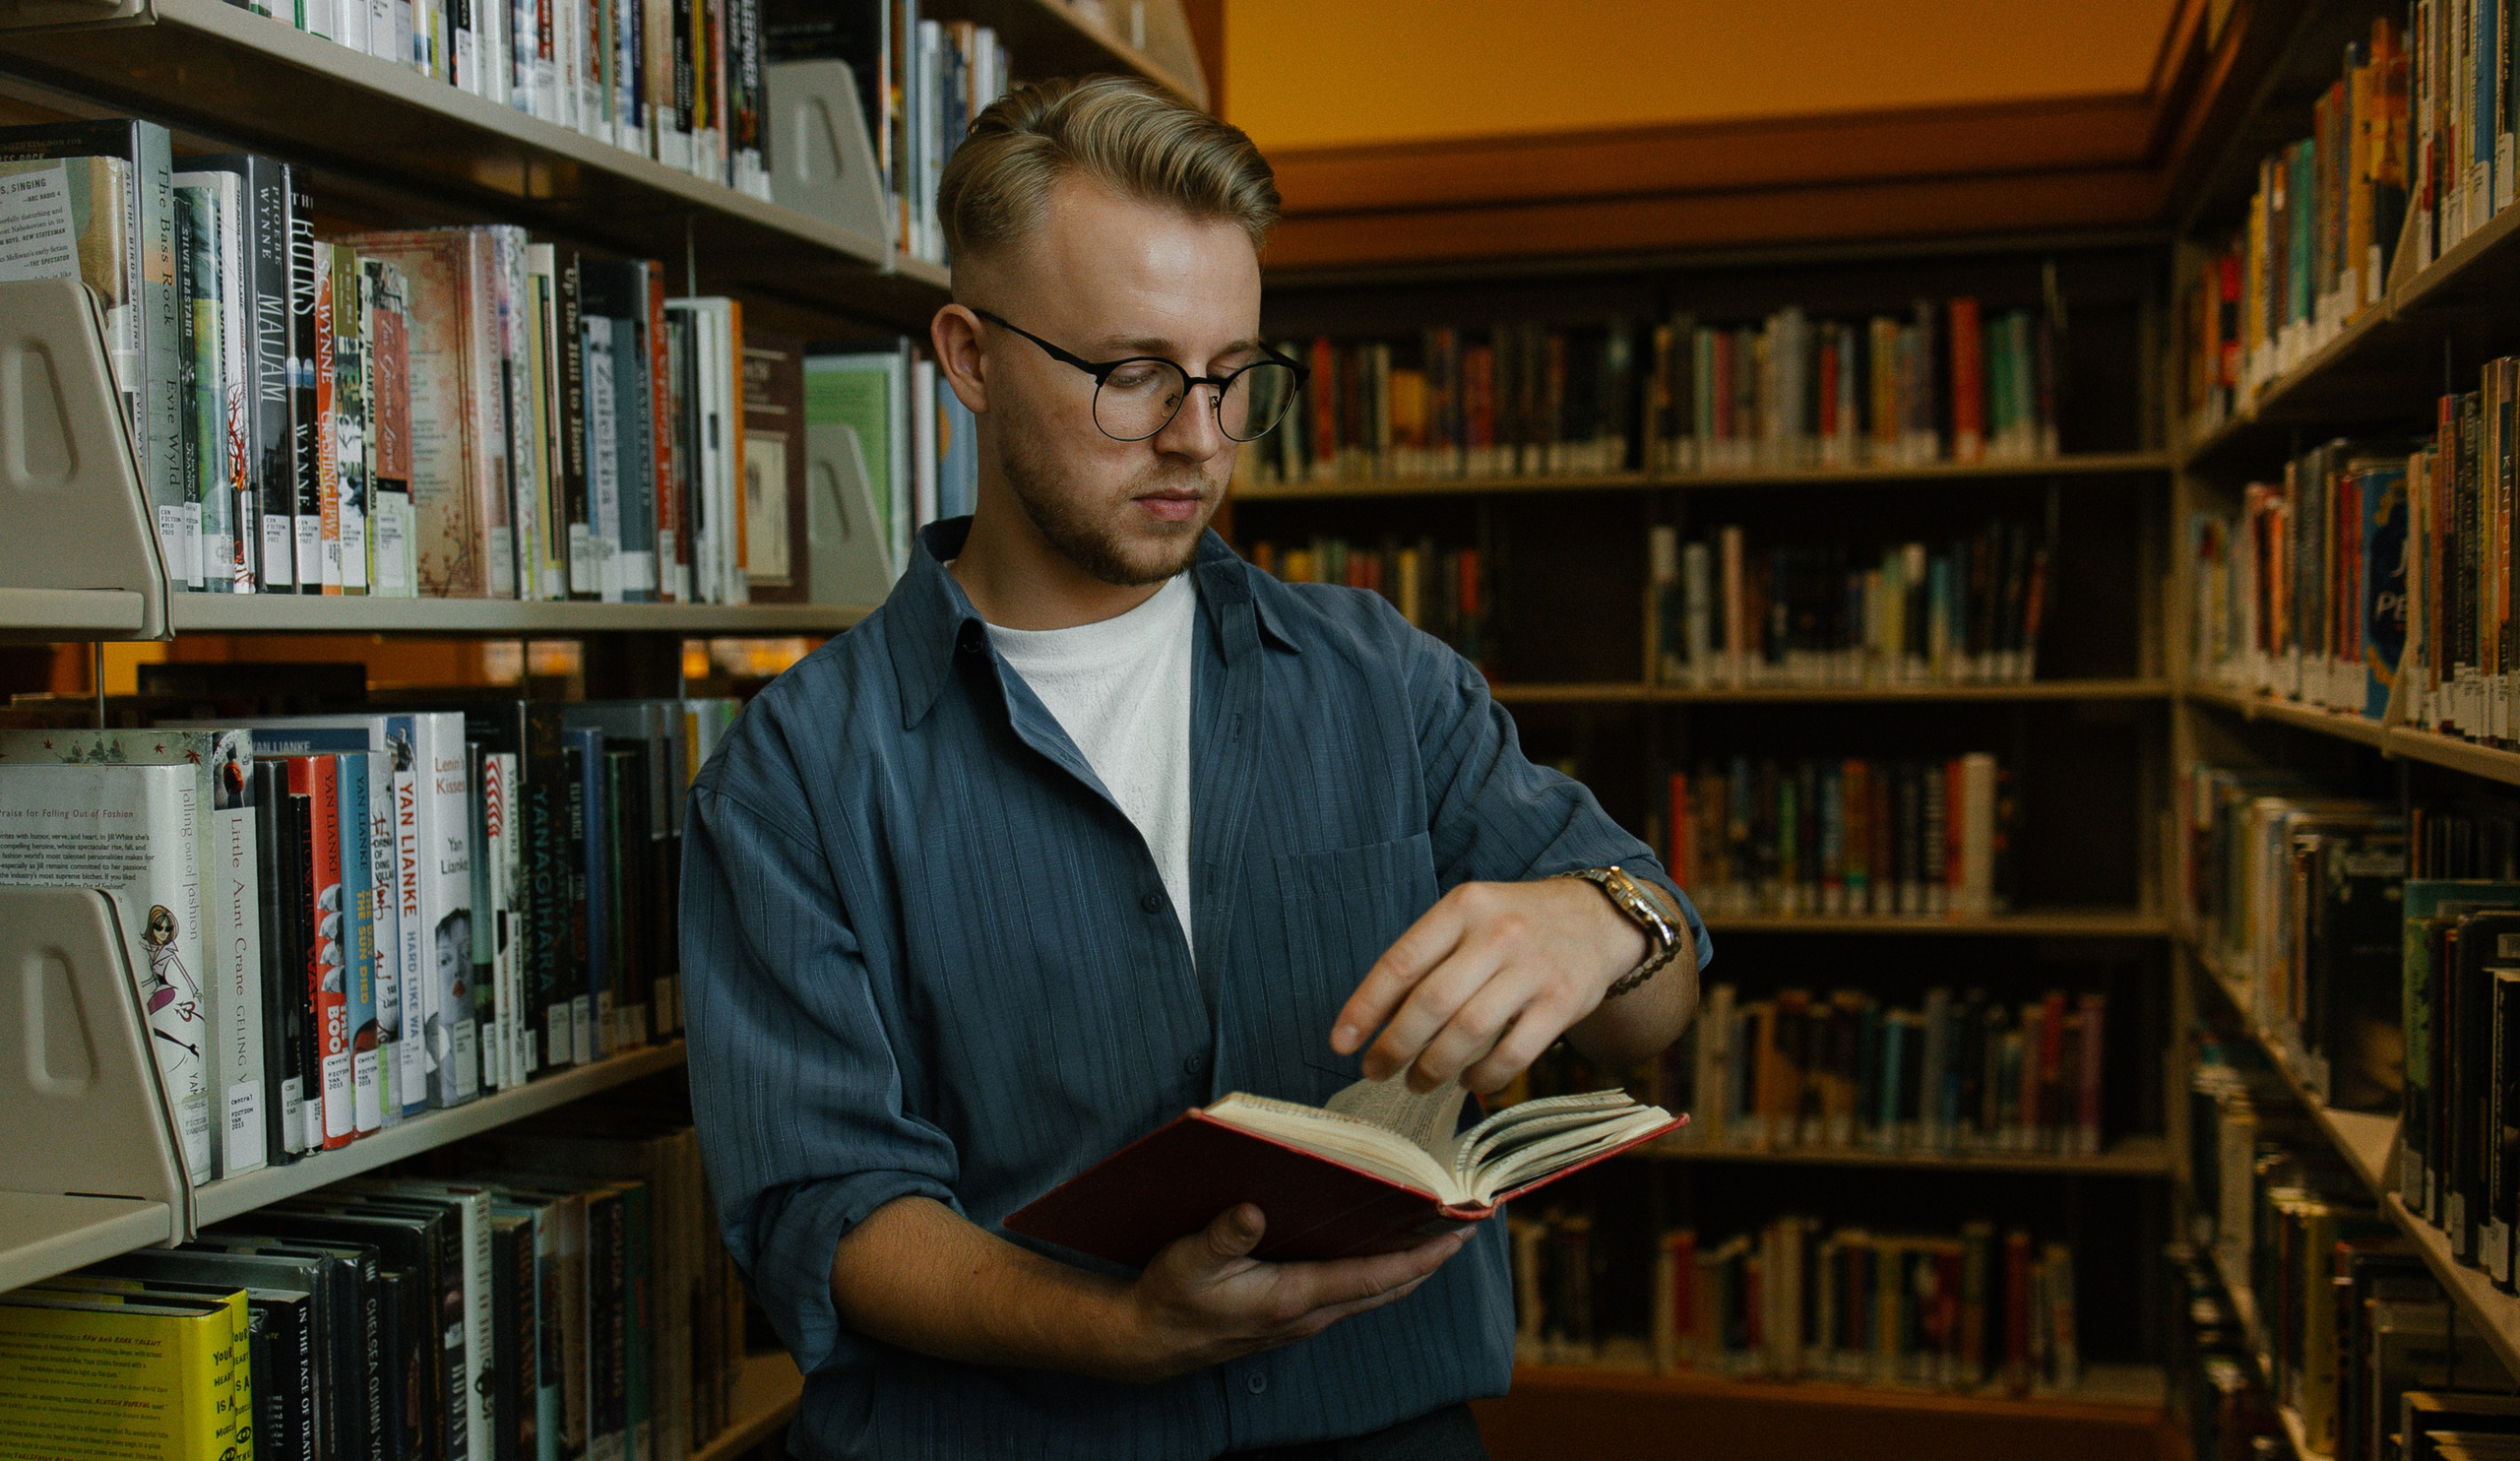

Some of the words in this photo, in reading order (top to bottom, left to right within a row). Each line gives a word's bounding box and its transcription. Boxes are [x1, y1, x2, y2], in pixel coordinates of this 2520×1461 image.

[12, 178, 46, 192] SINGING
[158, 165, 169, 209] The
[12, 222, 46, 233] Nabokovian
[22, 210, 50, 221] disturbing
[35, 228, 66, 238] STATESMAN
[260, 187, 272, 260] WYNNE
[272, 185, 282, 266] PHOEBE
[35, 247, 49, 256] early
[160, 218, 171, 263] Bass
[181, 227, 190, 269] SILVER
[41, 254, 70, 265] SPECTATOR
[290, 218, 315, 317] RUINS
[563, 267, 577, 296] Up
[162, 273, 175, 326] Rock
[183, 277, 193, 337] BASTARD
[565, 301, 578, 336] the
[318, 303, 334, 385] WYNNE
[166, 380, 177, 423] Evie
[570, 387, 581, 410] to
[164, 434, 180, 485] Wyld
[321, 411, 339, 499] CRASHING
[571, 417, 584, 476] Home
[296, 422, 310, 507] WYNNE
[273, 740, 311, 752] LIANKE
[324, 774, 335, 808] YAN
[356, 776, 365, 809] YAN
[400, 783, 413, 826] YAN
[26, 808, 38, 817] for
[42, 808, 70, 819] Falling
[73, 809, 88, 818] Out
[91, 808, 99, 819] of
[102, 809, 134, 818] Fashion
[179, 789, 194, 838] falling
[1, 842, 31, 852] compelling
[32, 842, 56, 851] heroine,
[78, 843, 110, 852] spectacular
[31, 832, 51, 841] humor,
[135, 833, 150, 842] she's
[232, 816, 243, 869] Little
[326, 812, 338, 878] LIANKE
[358, 811, 369, 871] LIANKE
[448, 837, 464, 852] Yan
[46, 852, 61, 860] most
[88, 853, 124, 862] personalities
[111, 862, 121, 871] her
[123, 862, 147, 872] passions
[440, 859, 470, 875] Lianke
[11, 871, 37, 882] industry's
[56, 872, 80, 883] supreme
[83, 872, 103, 881] bitches.
[401, 836, 417, 918] LIANKE
[533, 788, 556, 993] YANAGIHARA
[183, 882, 198, 941] fashion
[233, 879, 245, 929] Aunt
[356, 889, 365, 921] THE
[358, 925, 367, 961] SUN
[407, 930, 417, 972] HARD
[234, 937, 247, 996] Crane
[359, 965, 368, 1004] DIED
[409, 979, 419, 1011] LIKE
[237, 1005, 248, 1068] GELING
[327, 1055, 349, 1066] Central
[230, 1094, 253, 1106] Central
[231, 1108, 254, 1117] FICTION
[298, 1306, 308, 1323] IN
[299, 1325, 308, 1357] THE
[365, 1298, 379, 1375] CHELSEA
[213, 1346, 233, 1366] YOUR
[214, 1370, 234, 1387] HEART
[243, 1375, 250, 1392] A
[300, 1359, 309, 1395] FACE
[217, 1400, 226, 1415] IS
[228, 1394, 235, 1411] A
[301, 1397, 311, 1417] OF
[367, 1375, 382, 1435] QUINN
